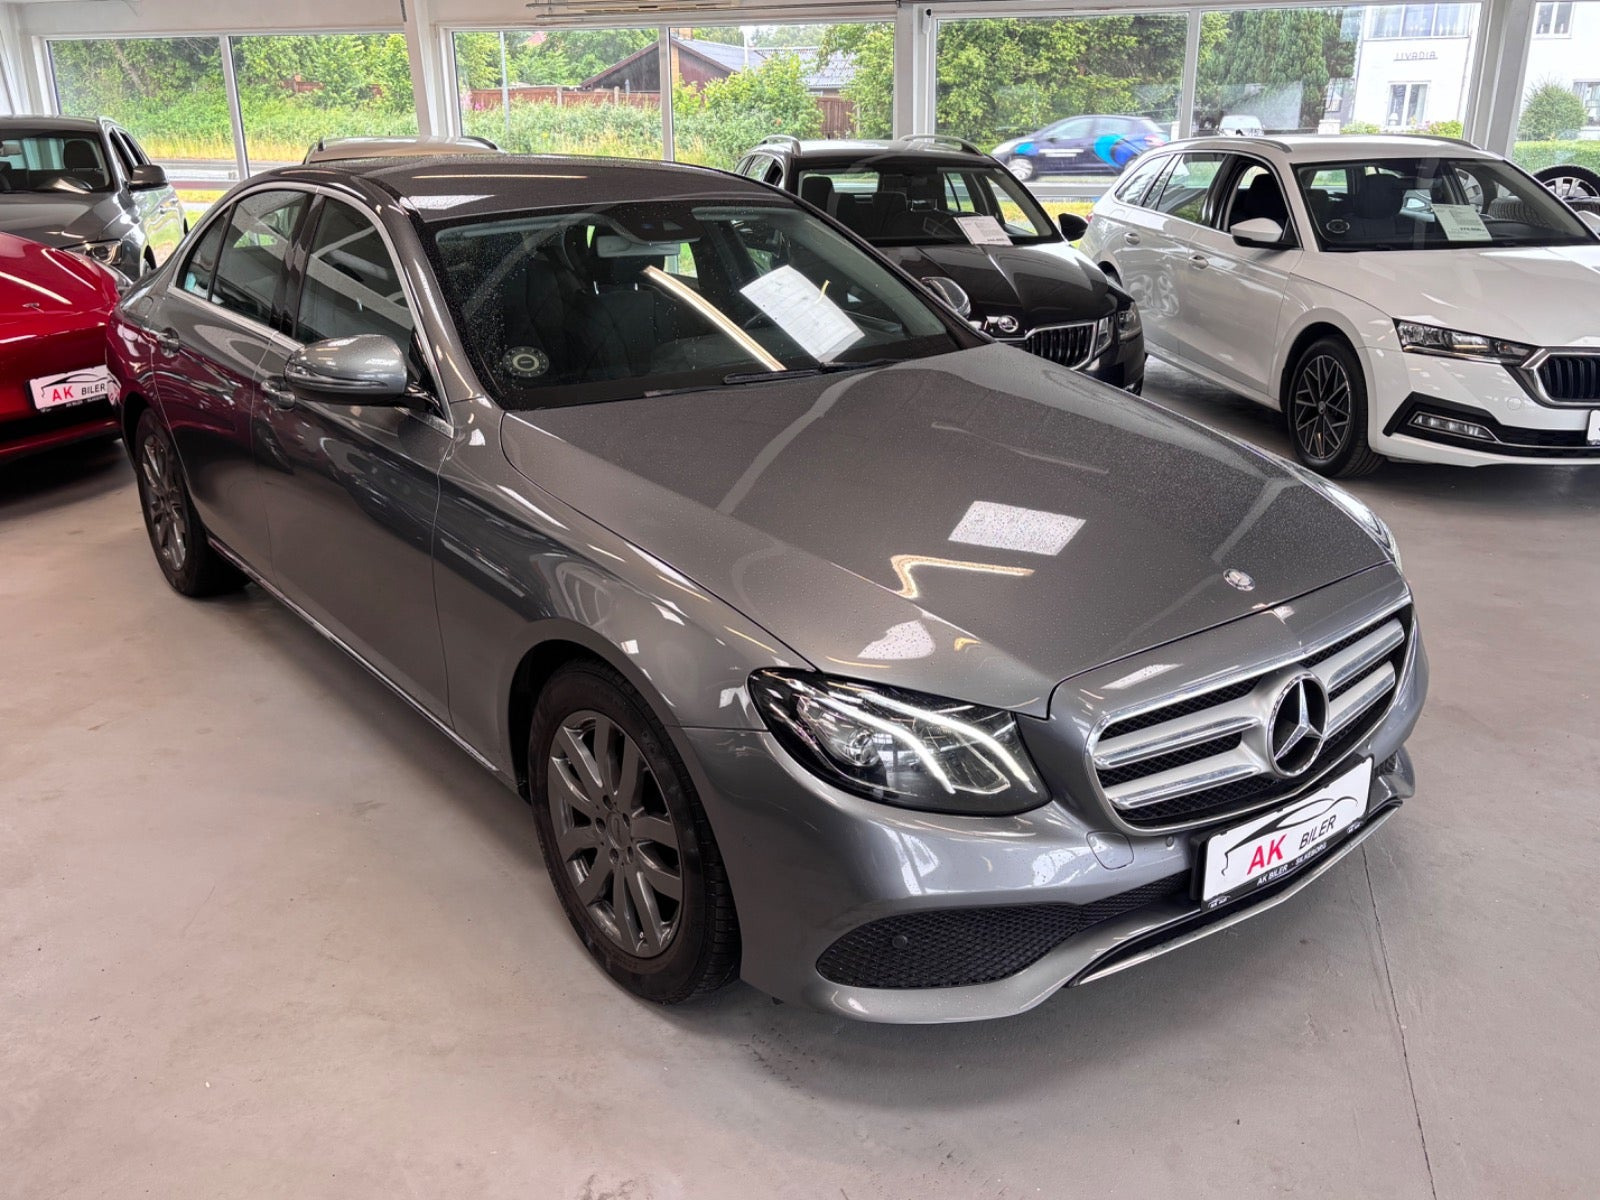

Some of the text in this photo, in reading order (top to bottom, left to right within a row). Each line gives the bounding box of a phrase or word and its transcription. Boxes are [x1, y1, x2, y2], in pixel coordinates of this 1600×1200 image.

[52, 386, 74, 402] AK
[81, 382, 105, 396] BILER
[1247, 814, 1337, 875] AK BILER
[1257, 875, 1268, 886] AK
[1269, 864, 1288, 880] BILER
